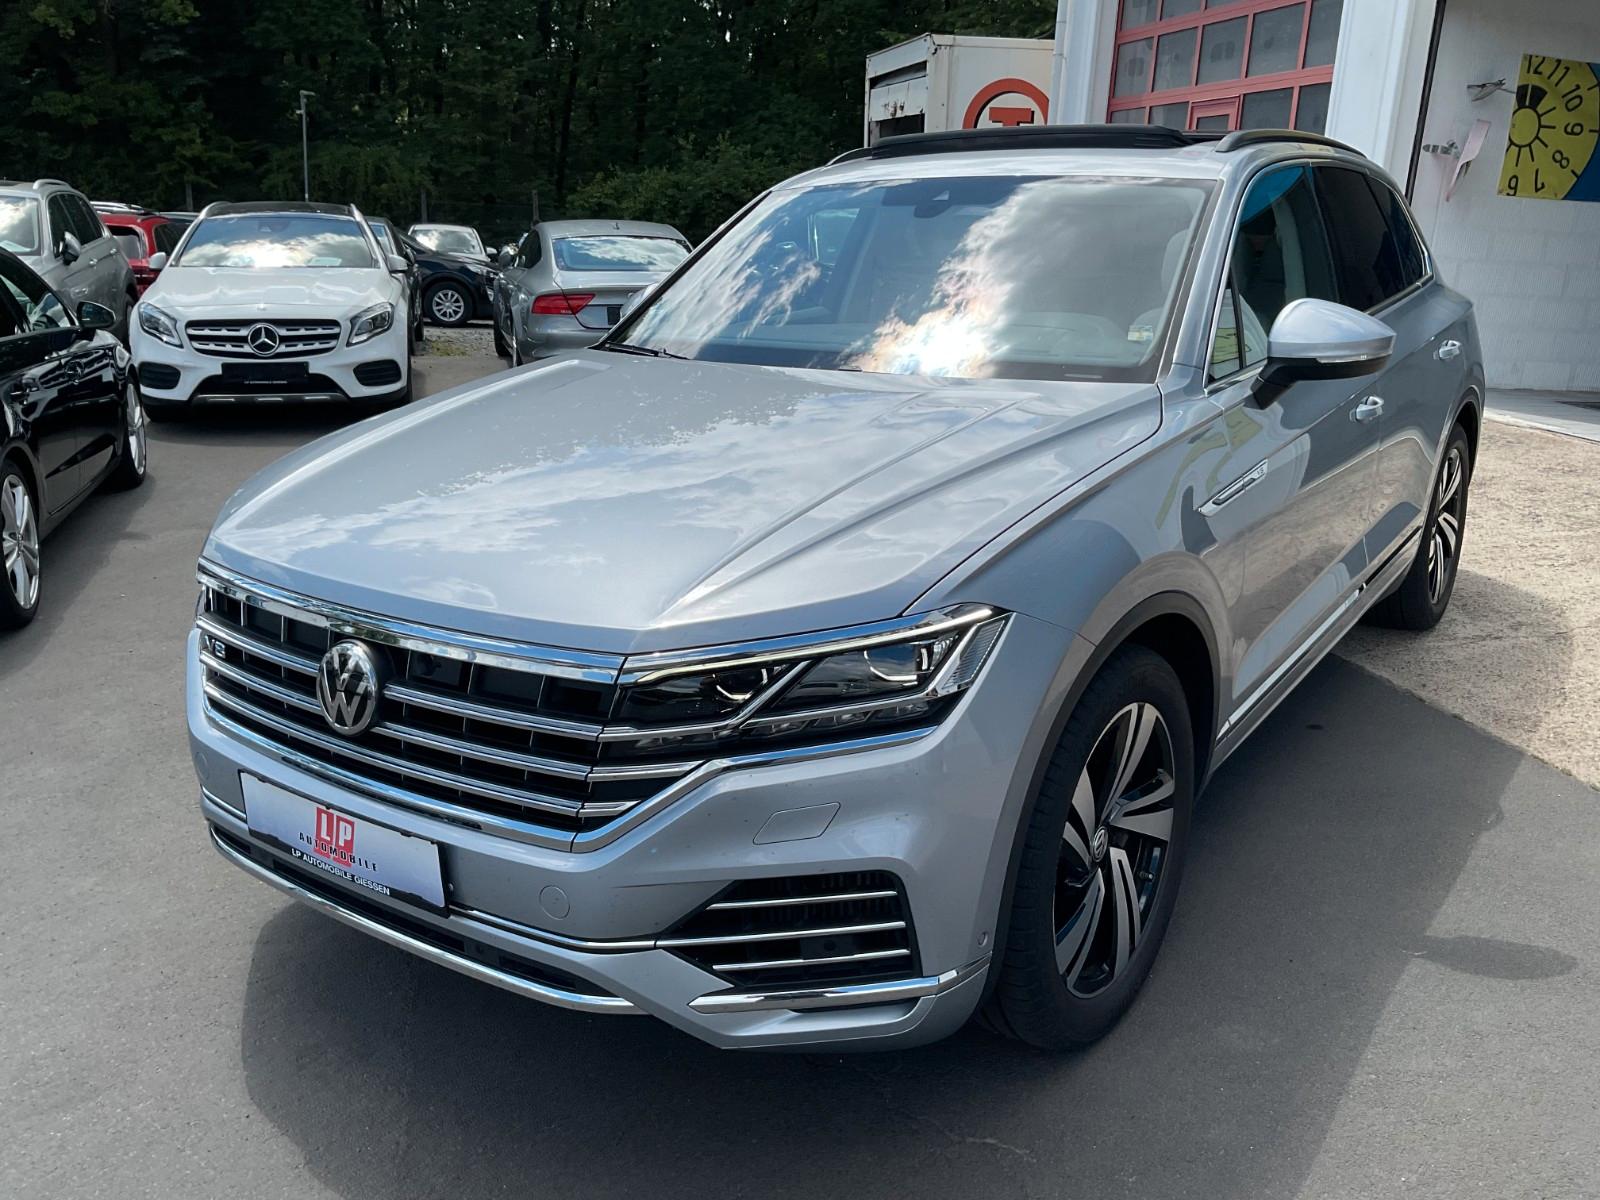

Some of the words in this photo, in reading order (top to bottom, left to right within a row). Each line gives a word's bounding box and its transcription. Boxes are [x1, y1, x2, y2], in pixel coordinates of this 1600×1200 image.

[1527, 54, 1546, 75] 12
[1547, 58, 1570, 87] 11
[1561, 84, 1583, 112] 10
[1564, 122, 1584, 136] 9
[1552, 150, 1570, 169] 8
[320, 813, 352, 847] LP
[299, 832, 378, 871] AUTOMOBILE
[291, 848, 301, 857] LP
[302, 854, 353, 881] AUTOMOBILE
[354, 876, 390, 896] GIESSEN
